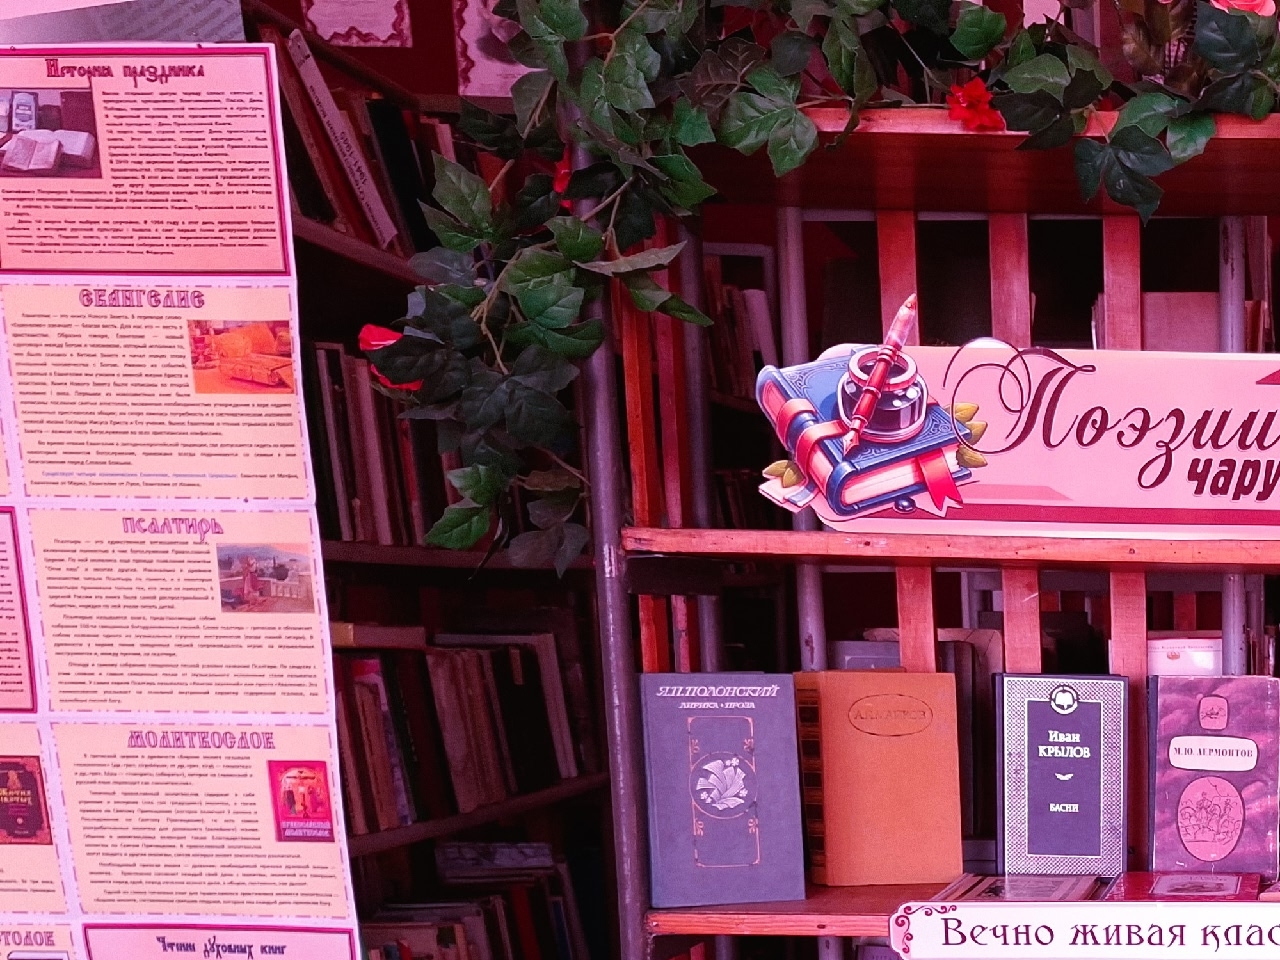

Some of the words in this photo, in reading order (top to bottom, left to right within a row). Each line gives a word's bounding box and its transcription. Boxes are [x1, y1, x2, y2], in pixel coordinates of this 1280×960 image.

[1048, 730, 1081, 743] Иван
[1038, 746, 1091, 759] КРЫЛОВ
[1198, 747, 1253, 758] ЛЕРМОНТОВ
[1049, 803, 1079, 813] БАСНИ
[941, 917, 1054, 948] Вечно
[1070, 923, 1187, 948] живая
